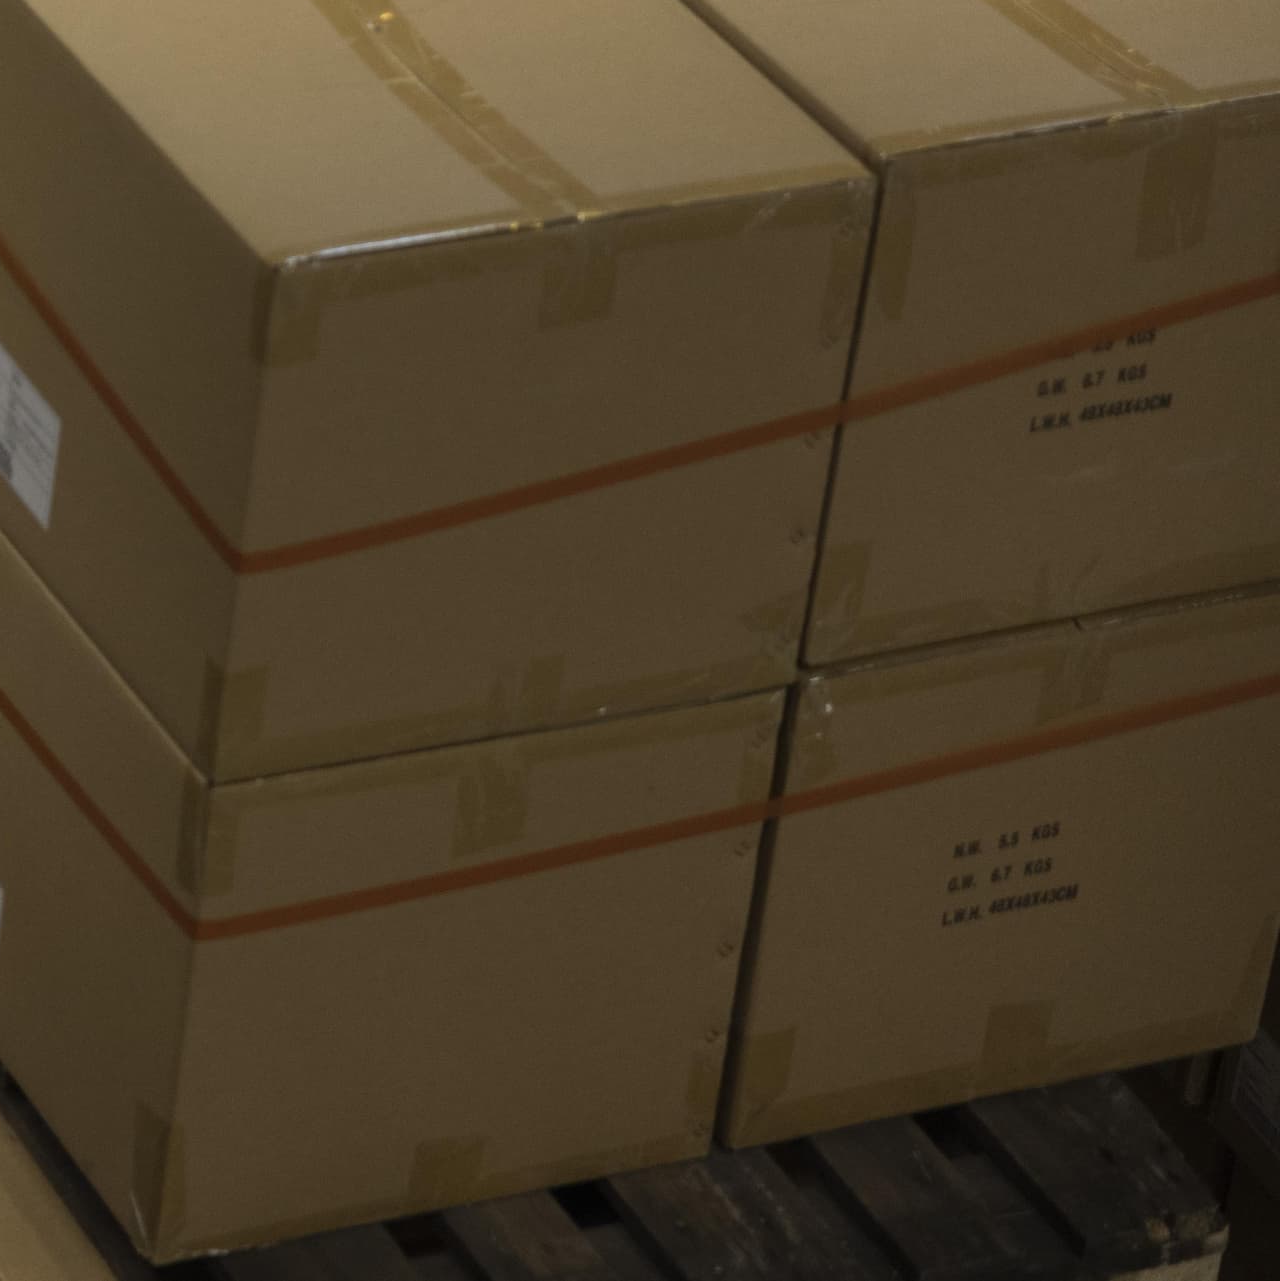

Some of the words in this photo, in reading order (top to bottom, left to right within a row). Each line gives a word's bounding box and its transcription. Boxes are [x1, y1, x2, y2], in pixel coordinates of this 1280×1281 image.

[1031, 820, 1061, 841] KGS
[990, 864, 1014, 883] 6.7
[1023, 857, 1054, 877] KGS
